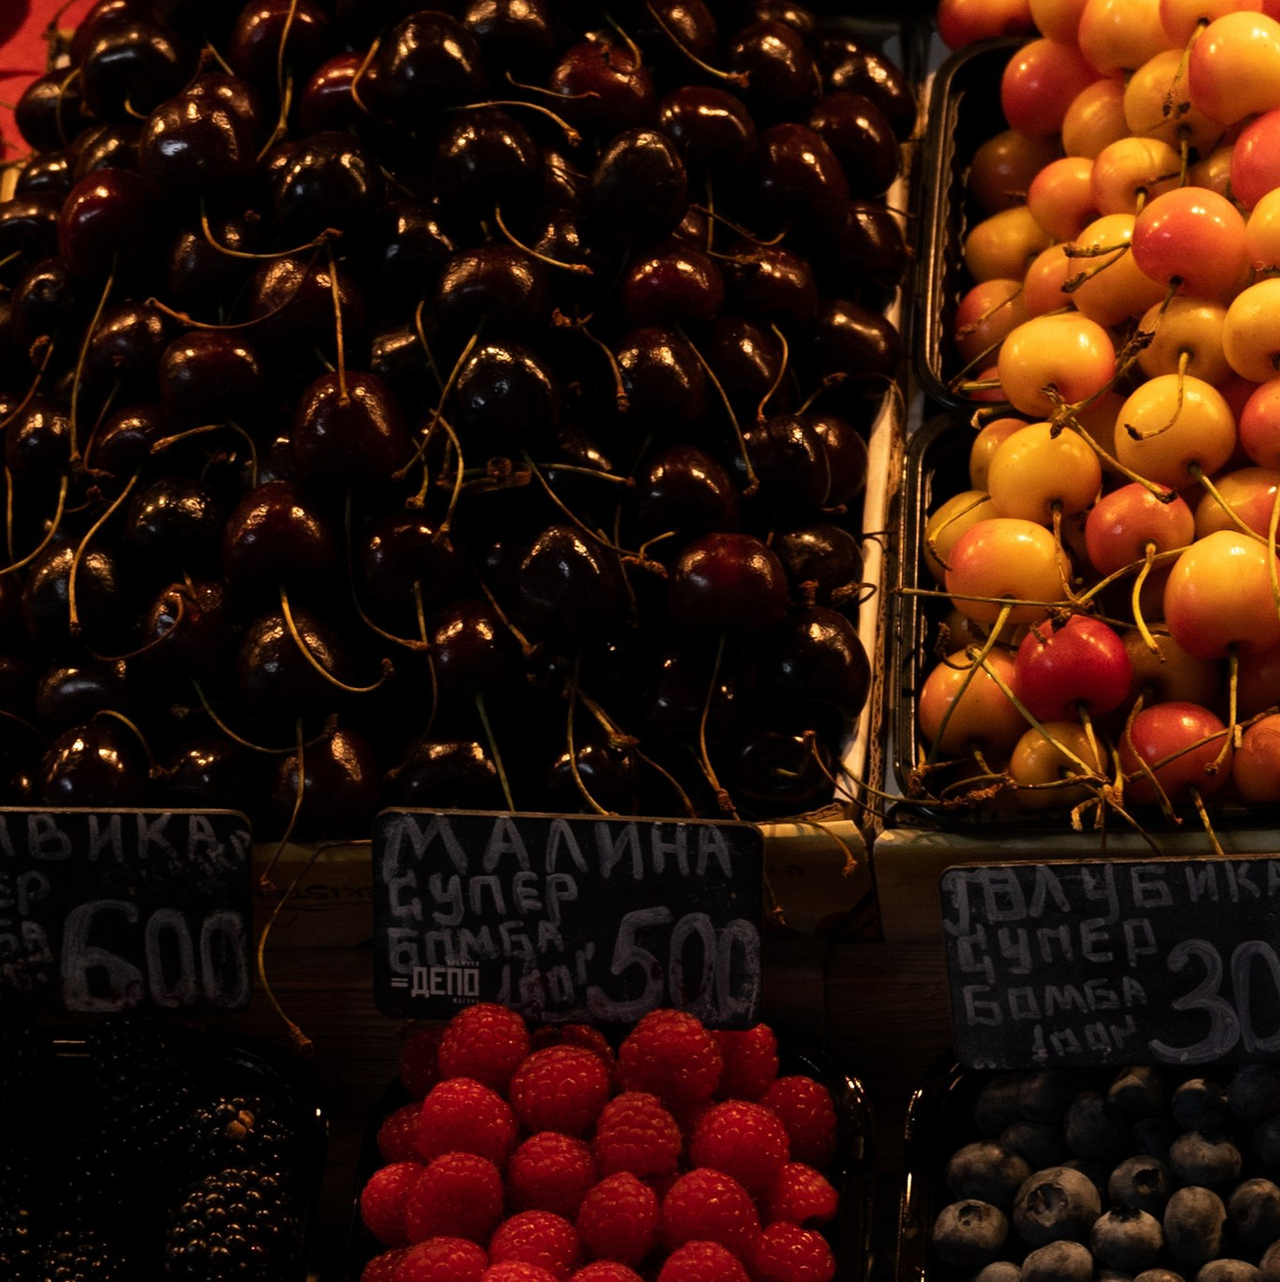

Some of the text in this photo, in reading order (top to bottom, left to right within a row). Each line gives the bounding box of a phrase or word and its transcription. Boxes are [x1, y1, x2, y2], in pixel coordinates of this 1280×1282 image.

[383, 814, 732, 883] МАЛИНА
[387, 869, 579, 925] СУПЕР
[60, 899, 250, 1012] 600
[386, 920, 564, 973] БОМБА
[587, 905, 761, 1021] 500
[957, 918, 1158, 984] СУПЕР
[410, 966, 479, 998] ДЕПО
[963, 976, 1148, 1025] БОМБА
